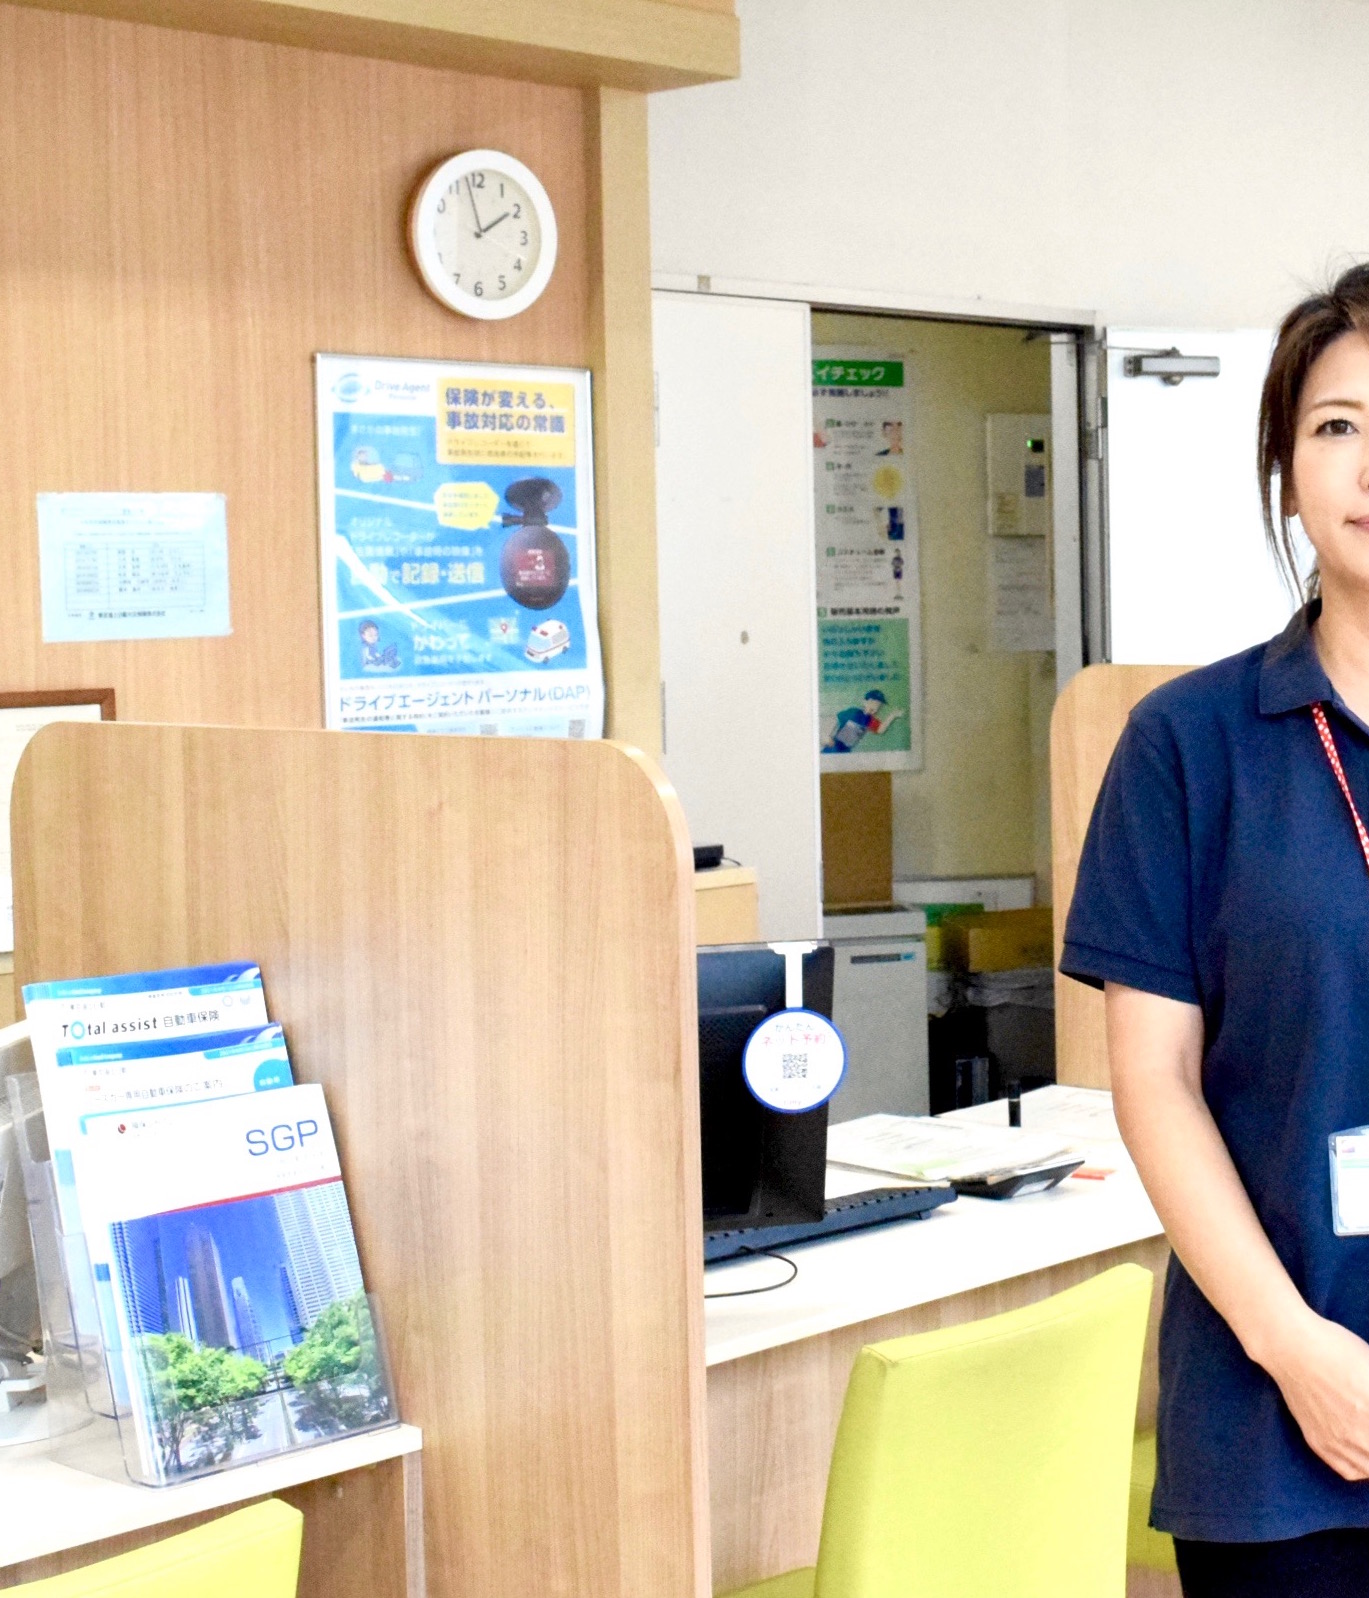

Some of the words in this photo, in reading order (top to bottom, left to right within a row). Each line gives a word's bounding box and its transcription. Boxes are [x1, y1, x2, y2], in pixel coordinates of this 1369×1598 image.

[471, 172, 485, 189] 12
[511, 203, 521, 219] 2
[520, 230, 529, 246] 3
[513, 258, 522, 271] 4
[453, 273, 461, 285] 7
[497, 275, 507, 291] 5
[473, 281, 484, 297] 6
[812, 366, 885, 381] イチェック
[402, 380, 431, 393] Agent
[445, 386, 556, 410] 保険が変える、
[445, 410, 567, 434] 事故対応の常識
[339, 690, 475, 713] ドライブエージェント
[111, 1017, 159, 1034] assist
[162, 1009, 221, 1029] 自動車保険
[761, 1033, 827, 1048] ネット予約
[245, 1118, 319, 1157] SGP
